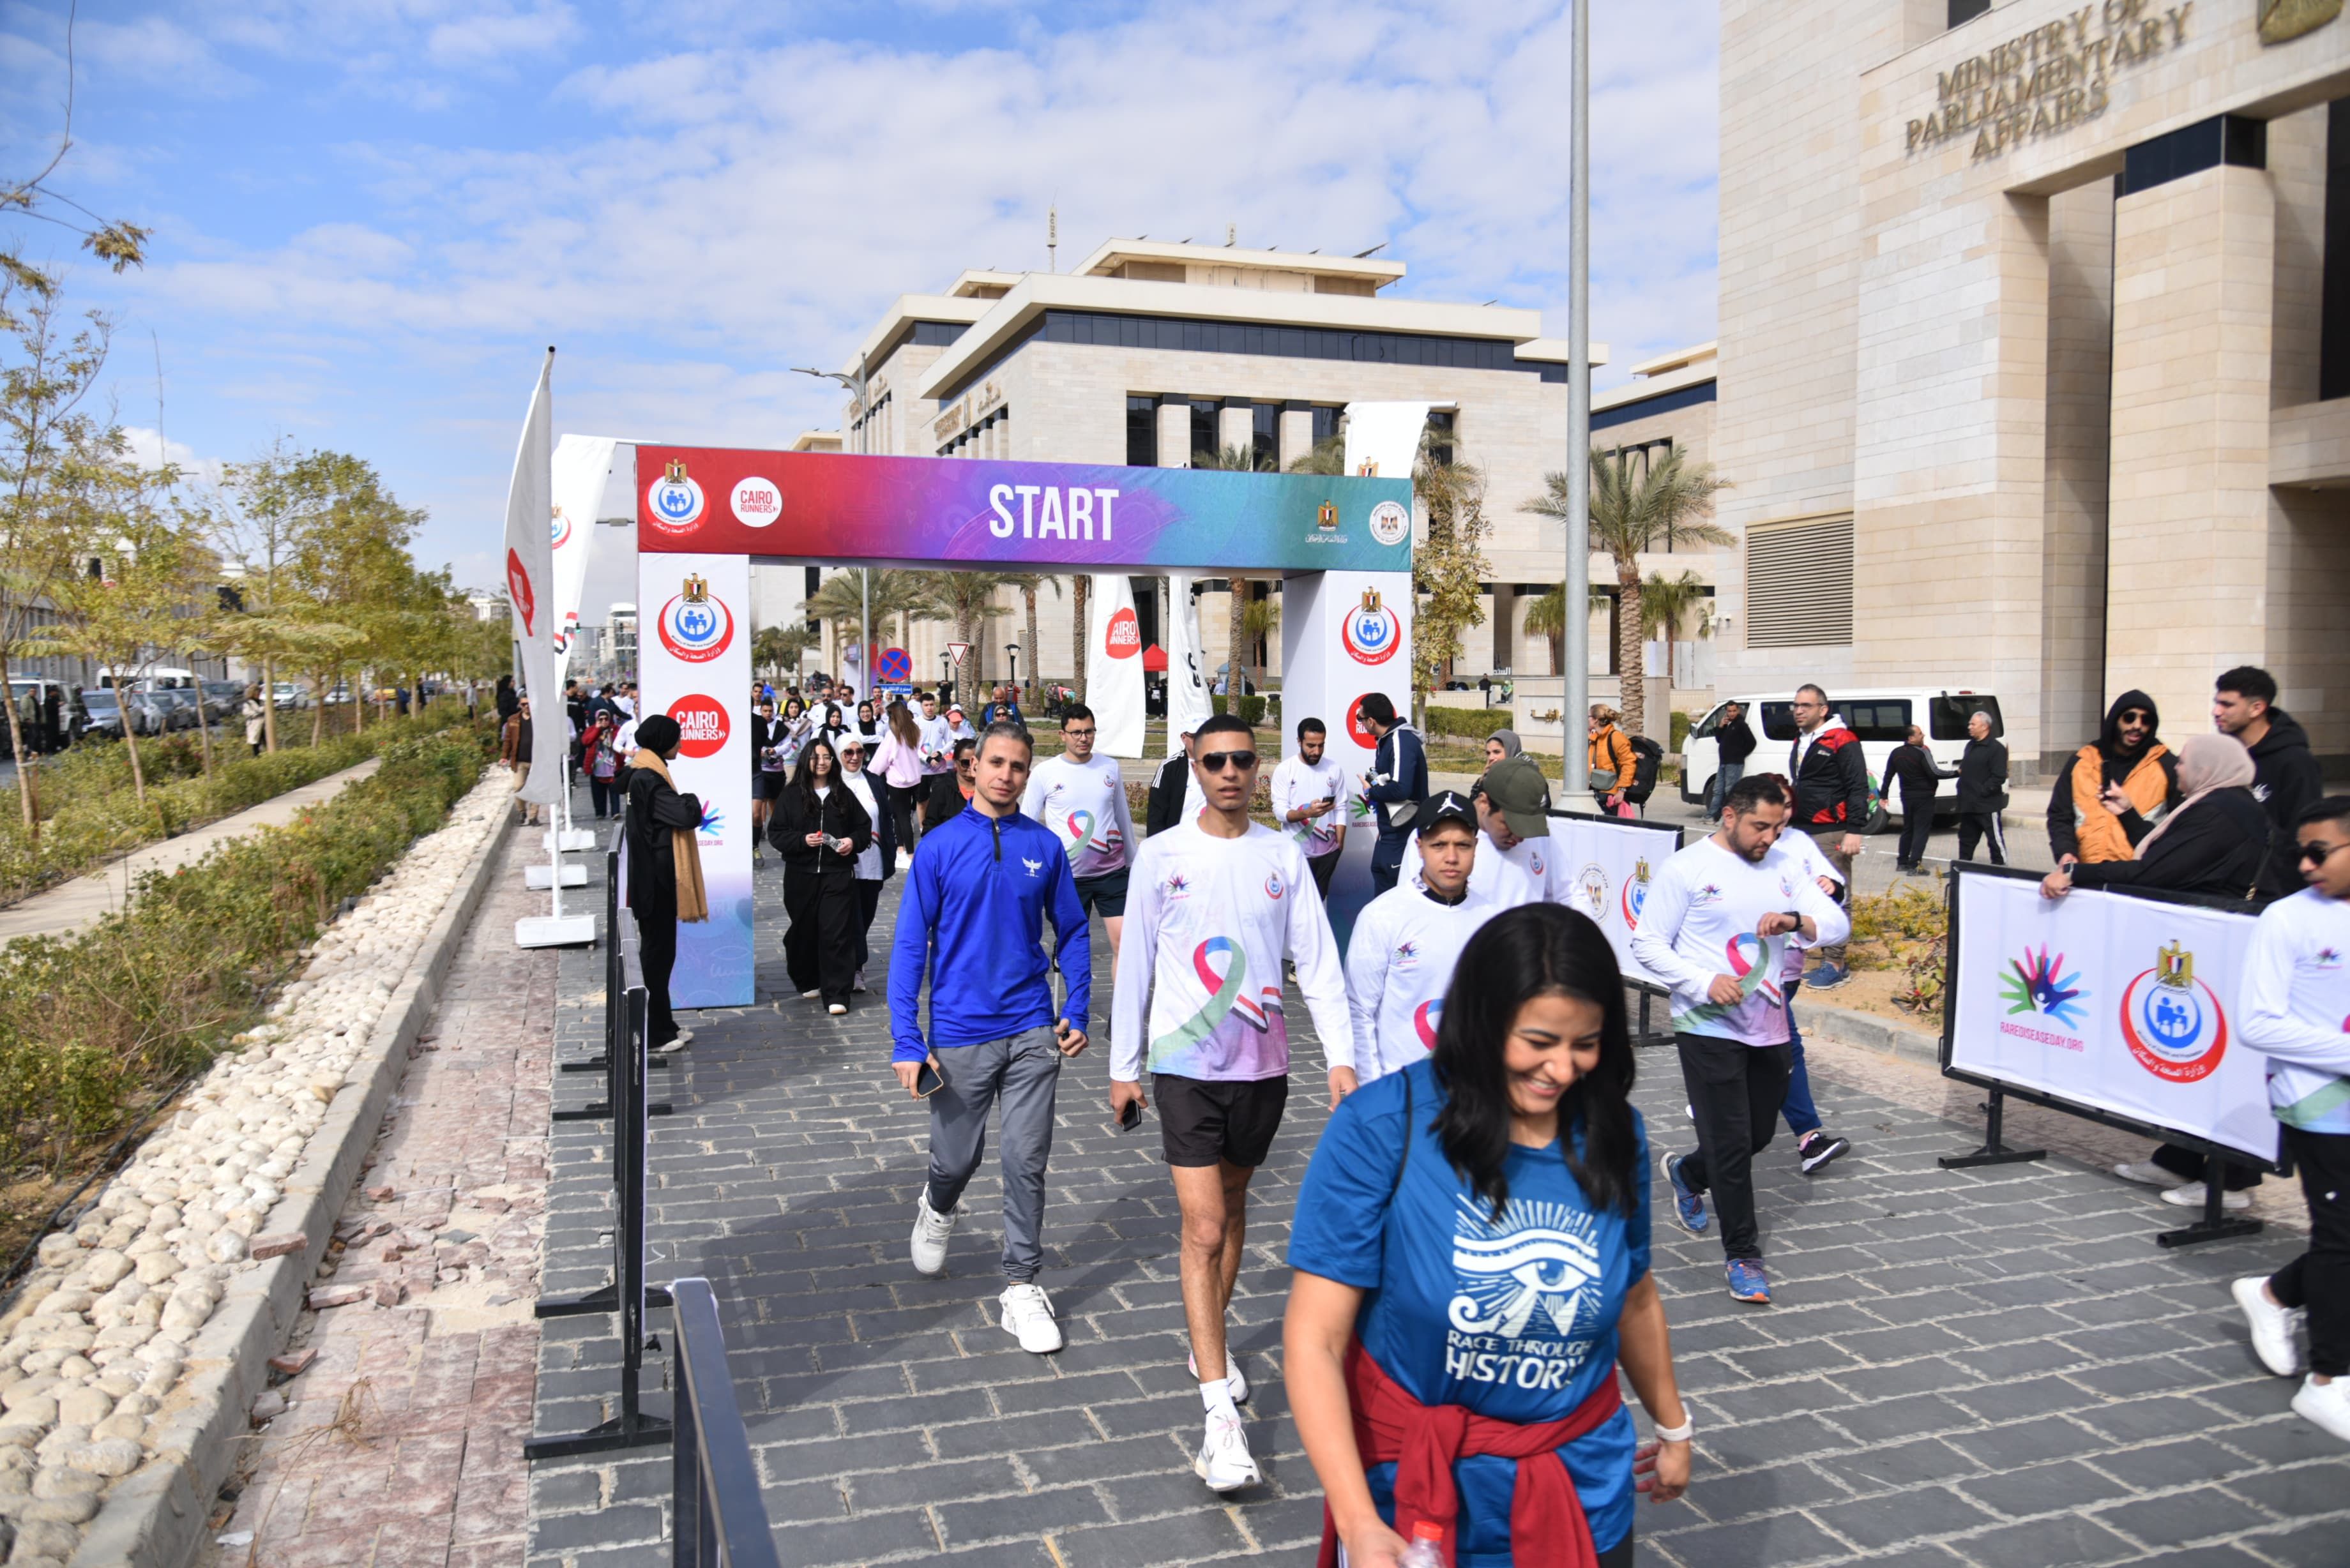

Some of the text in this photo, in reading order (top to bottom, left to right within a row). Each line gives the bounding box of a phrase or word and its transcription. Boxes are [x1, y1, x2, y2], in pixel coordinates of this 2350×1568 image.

[1937, 4, 2093, 101] MINISTRY
[1905, 1, 2194, 150] PARLIAMENTARY
[1971, 77, 2109, 160] AFFAIRS
[740, 490, 773, 504] CAIRO
[740, 504, 773, 513] RUNNERS
[989, 483, 1119, 541] START
[1109, 635, 1136, 645] NNERS
[1112, 621, 1136, 636] AIRO
[676, 711, 718, 729] CAIRO
[680, 728, 718, 741] UNNERS
[2000, 1021, 2084, 1053] RAREDISEASEDAY.ORG
[1447, 1329, 1594, 1357] RACE THROUGH
